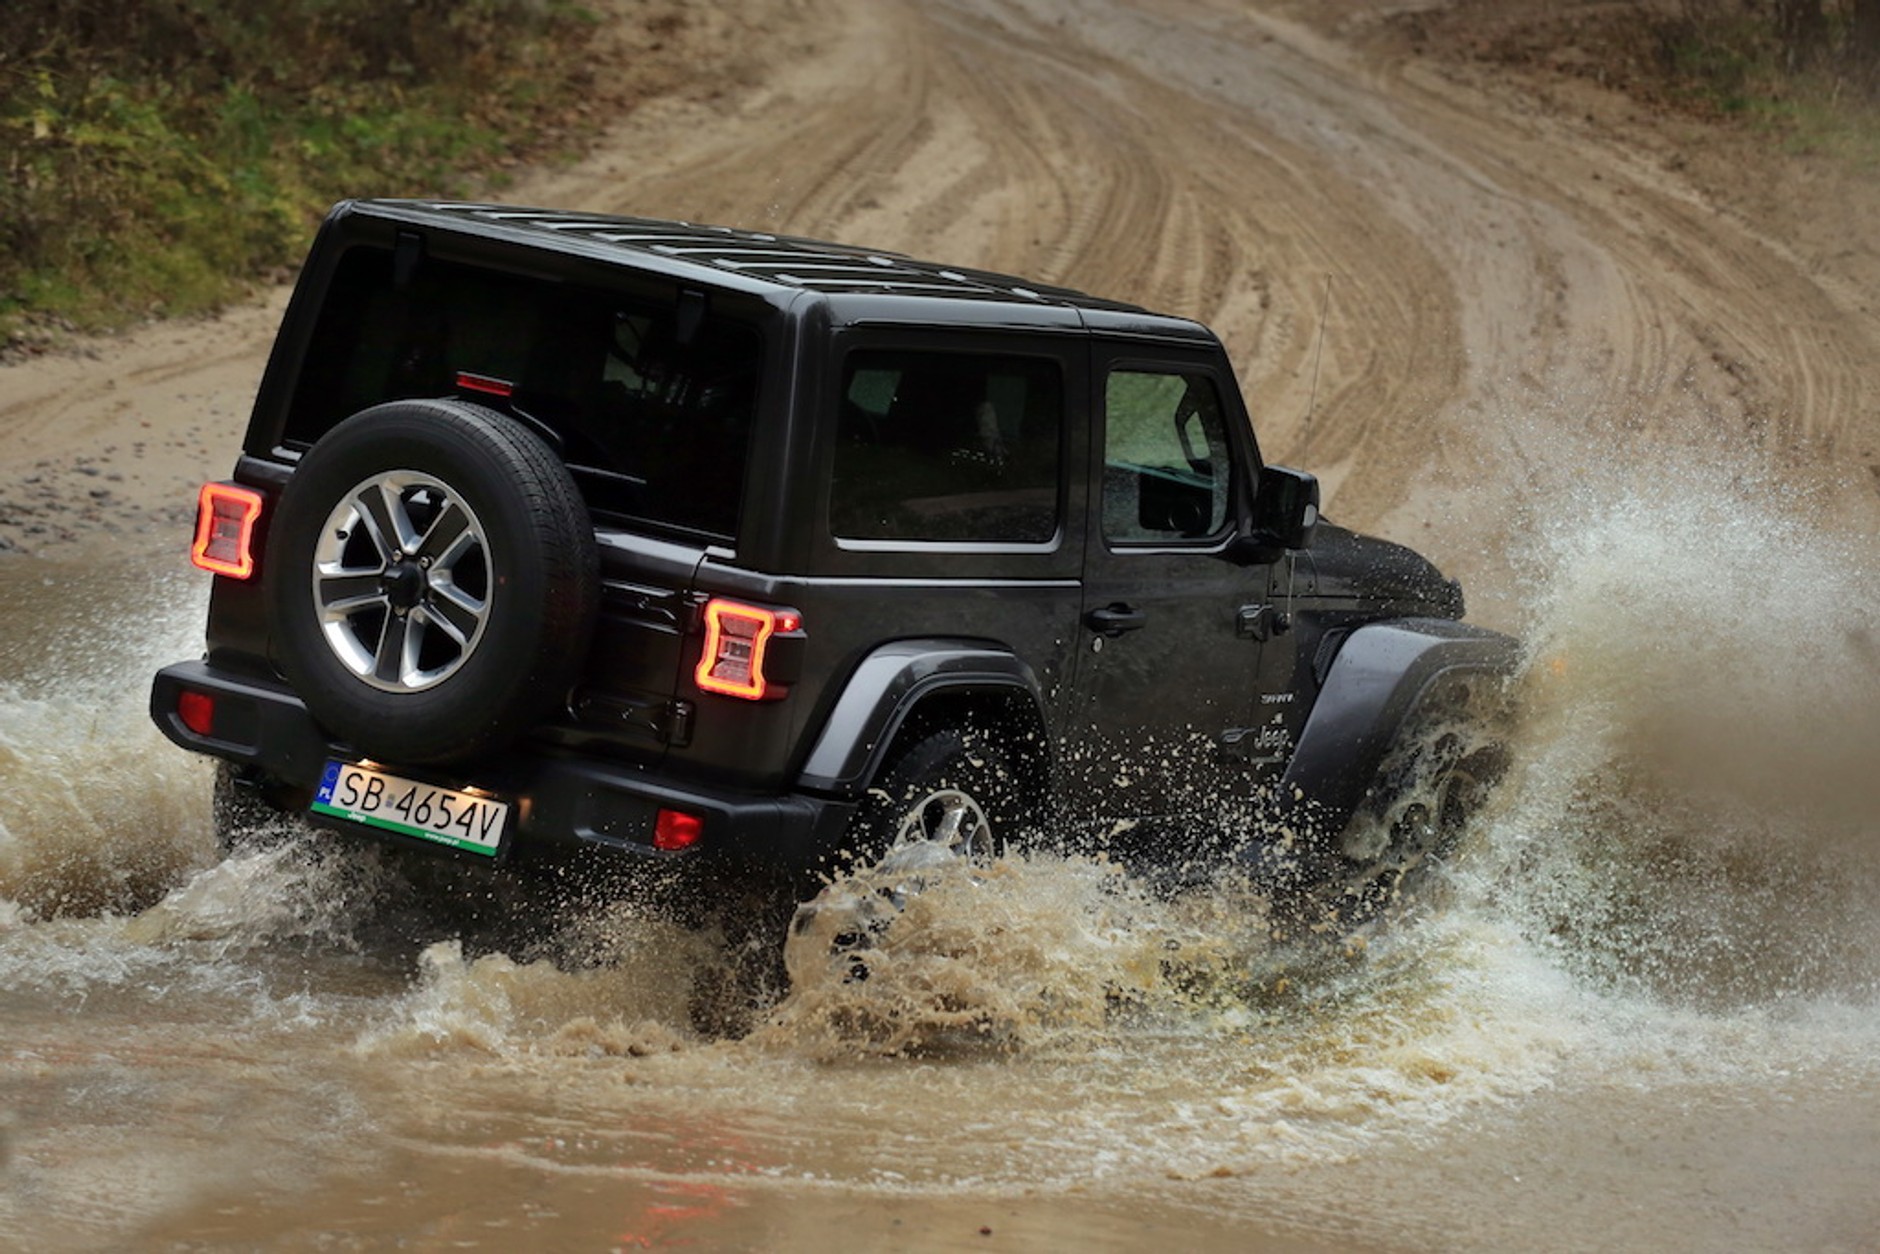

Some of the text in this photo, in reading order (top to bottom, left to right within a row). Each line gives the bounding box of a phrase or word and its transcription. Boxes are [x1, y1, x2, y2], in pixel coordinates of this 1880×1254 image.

[1254, 725, 1290, 752] Jeep
[318, 786, 331, 799] PL
[340, 772, 499, 840] SB 4654V
